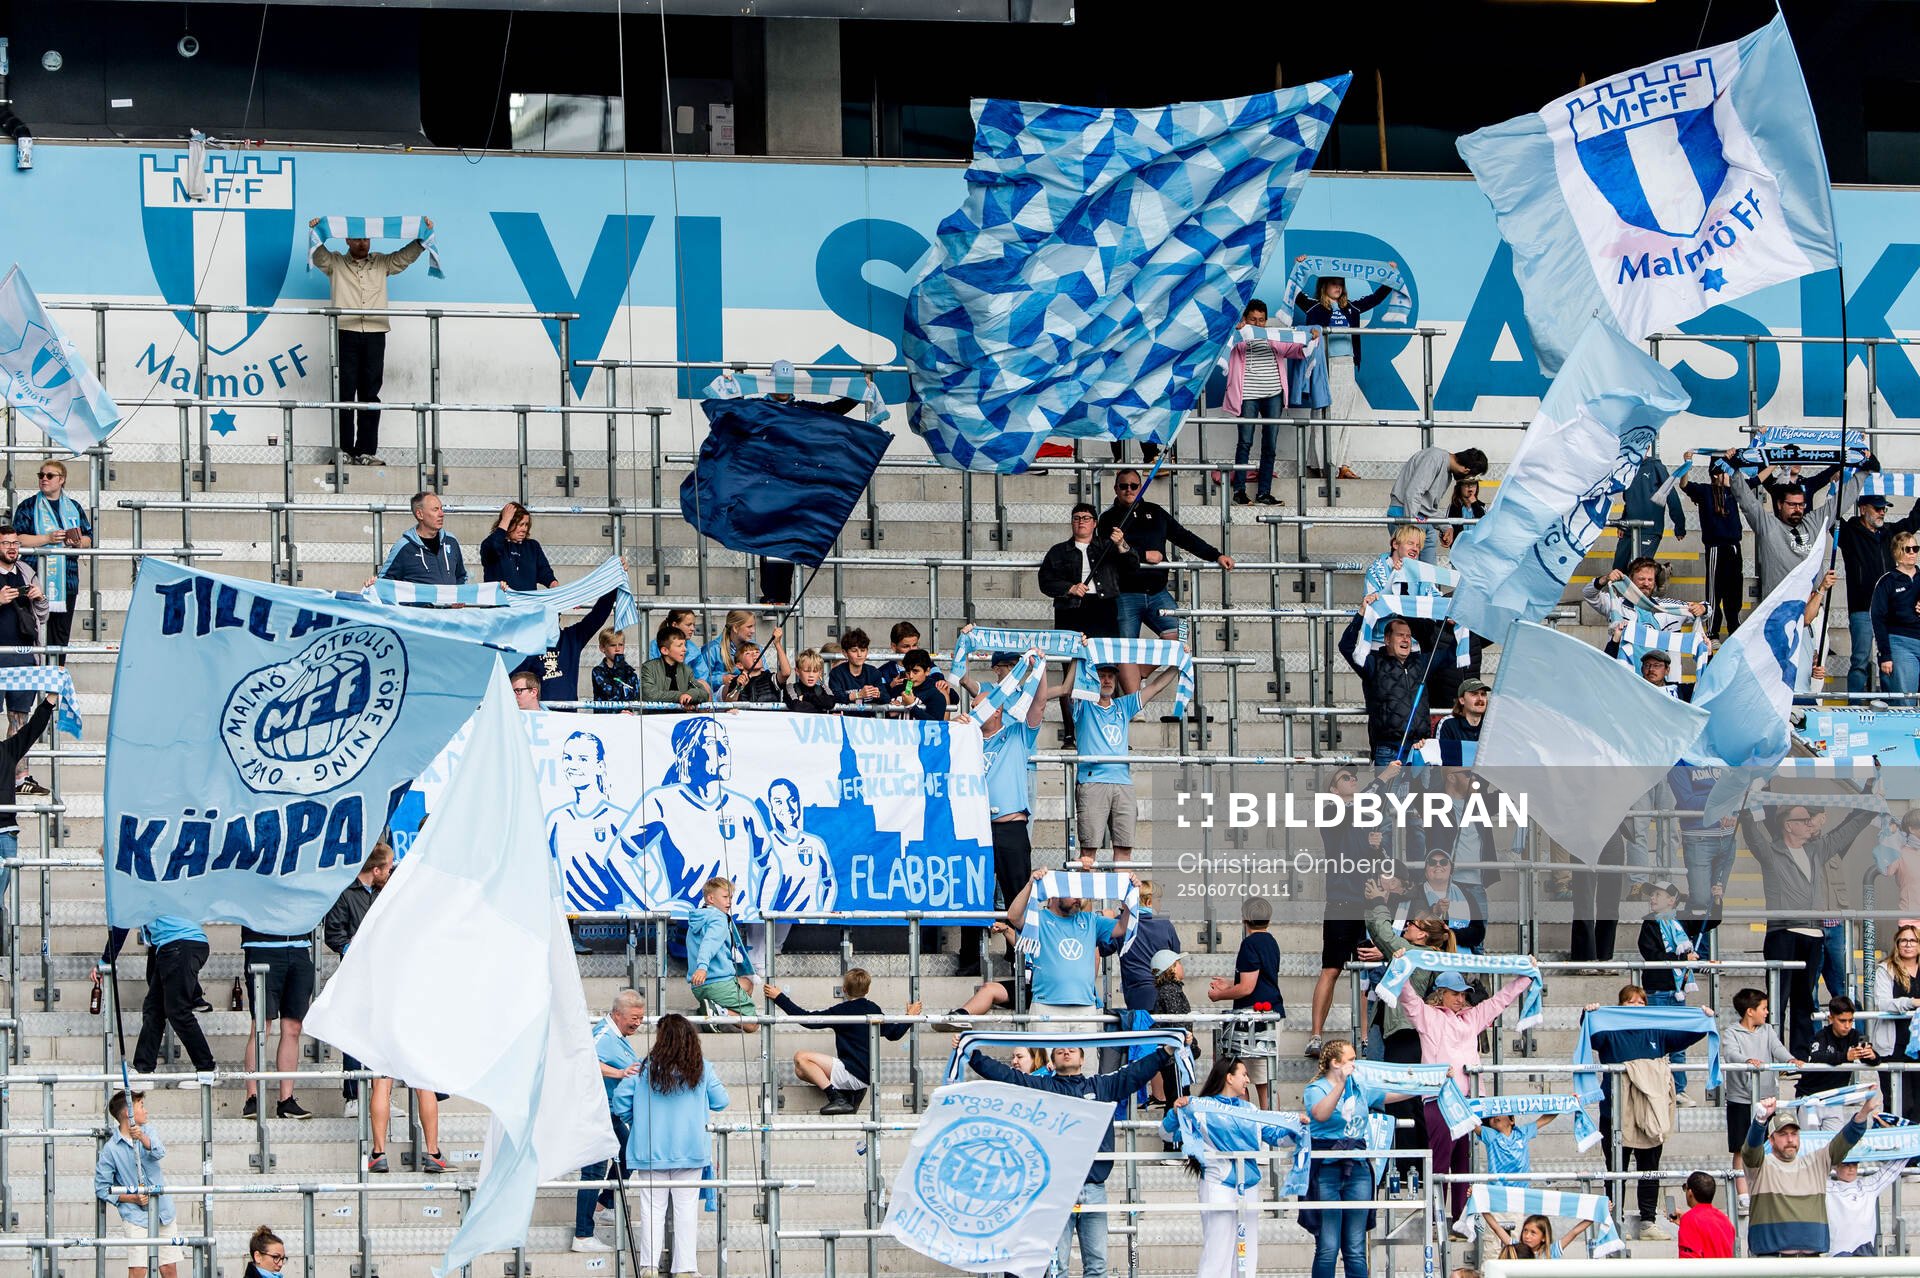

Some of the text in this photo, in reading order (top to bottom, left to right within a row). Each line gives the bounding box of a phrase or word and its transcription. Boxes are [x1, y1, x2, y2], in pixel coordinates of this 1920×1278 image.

[1617, 219, 1737, 285] Malmö
[1294, 258, 1404, 284] MFF Support
[14, 369, 38, 400] Malmö
[135, 342, 310, 399] Malmö FF
[1770, 449, 1795, 459] MFF
[970, 629, 1052, 650] MALMÖ
[227, 669, 287, 738] MALMÖ
[262, 666, 363, 741] MFF
[313, 667, 400, 782] FÖRENING
[241, 758, 284, 786] 1910
[857, 752, 907, 774] TILL
[826, 771, 986, 801] VERKLIGHETEN
[115, 796, 363, 882] KÄMPA
[851, 854, 986, 910] FLABBEN
[1516, 1095, 1581, 1115] MALMÖ
